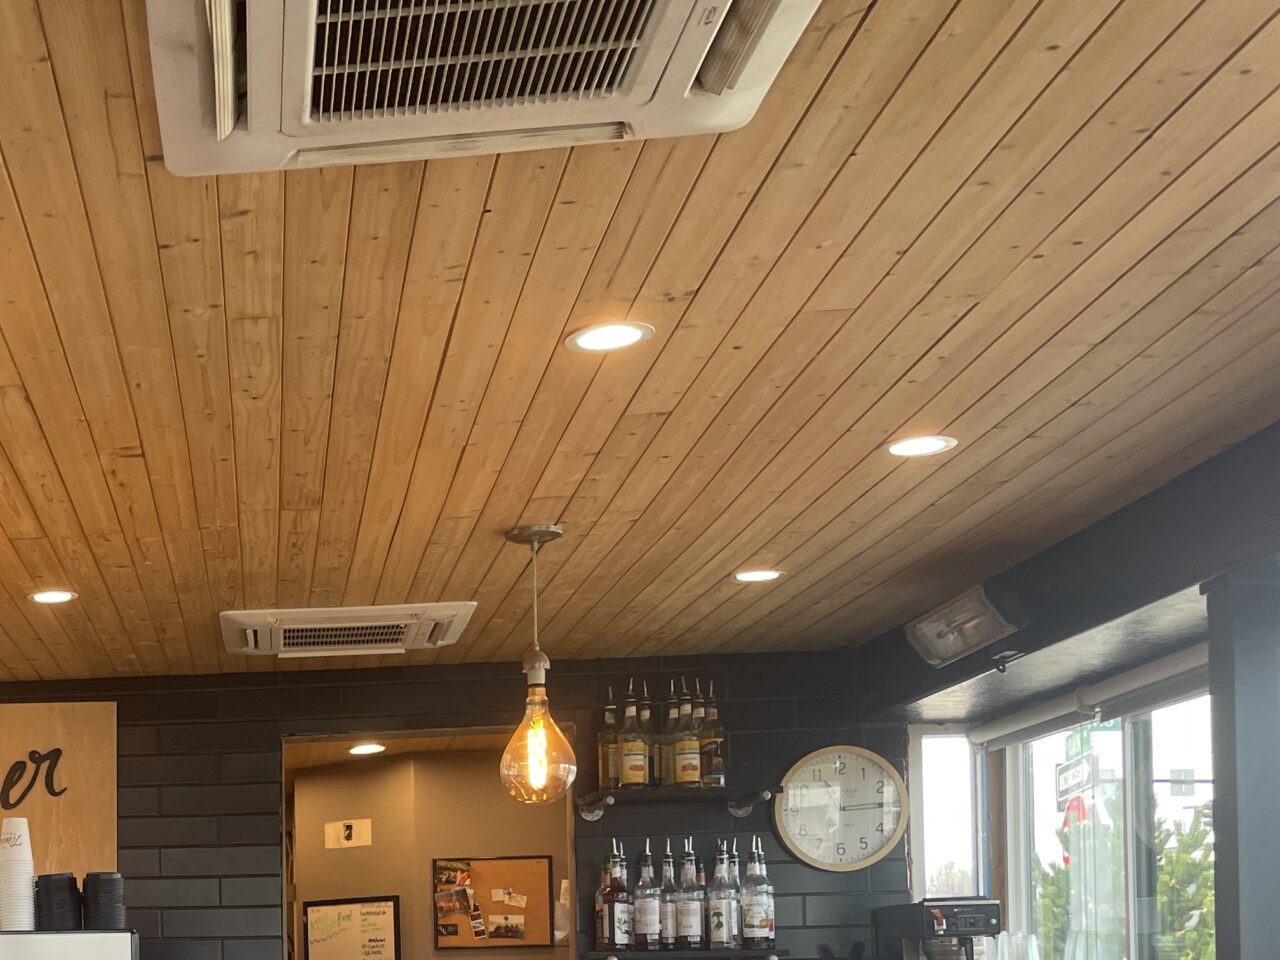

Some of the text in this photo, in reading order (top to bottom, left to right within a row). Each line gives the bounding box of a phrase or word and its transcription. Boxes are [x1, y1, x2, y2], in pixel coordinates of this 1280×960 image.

[876, 781, 884, 794] 2
[876, 822, 884, 834] 4
[836, 843, 846, 856] 6
[860, 837, 868, 850] 5
